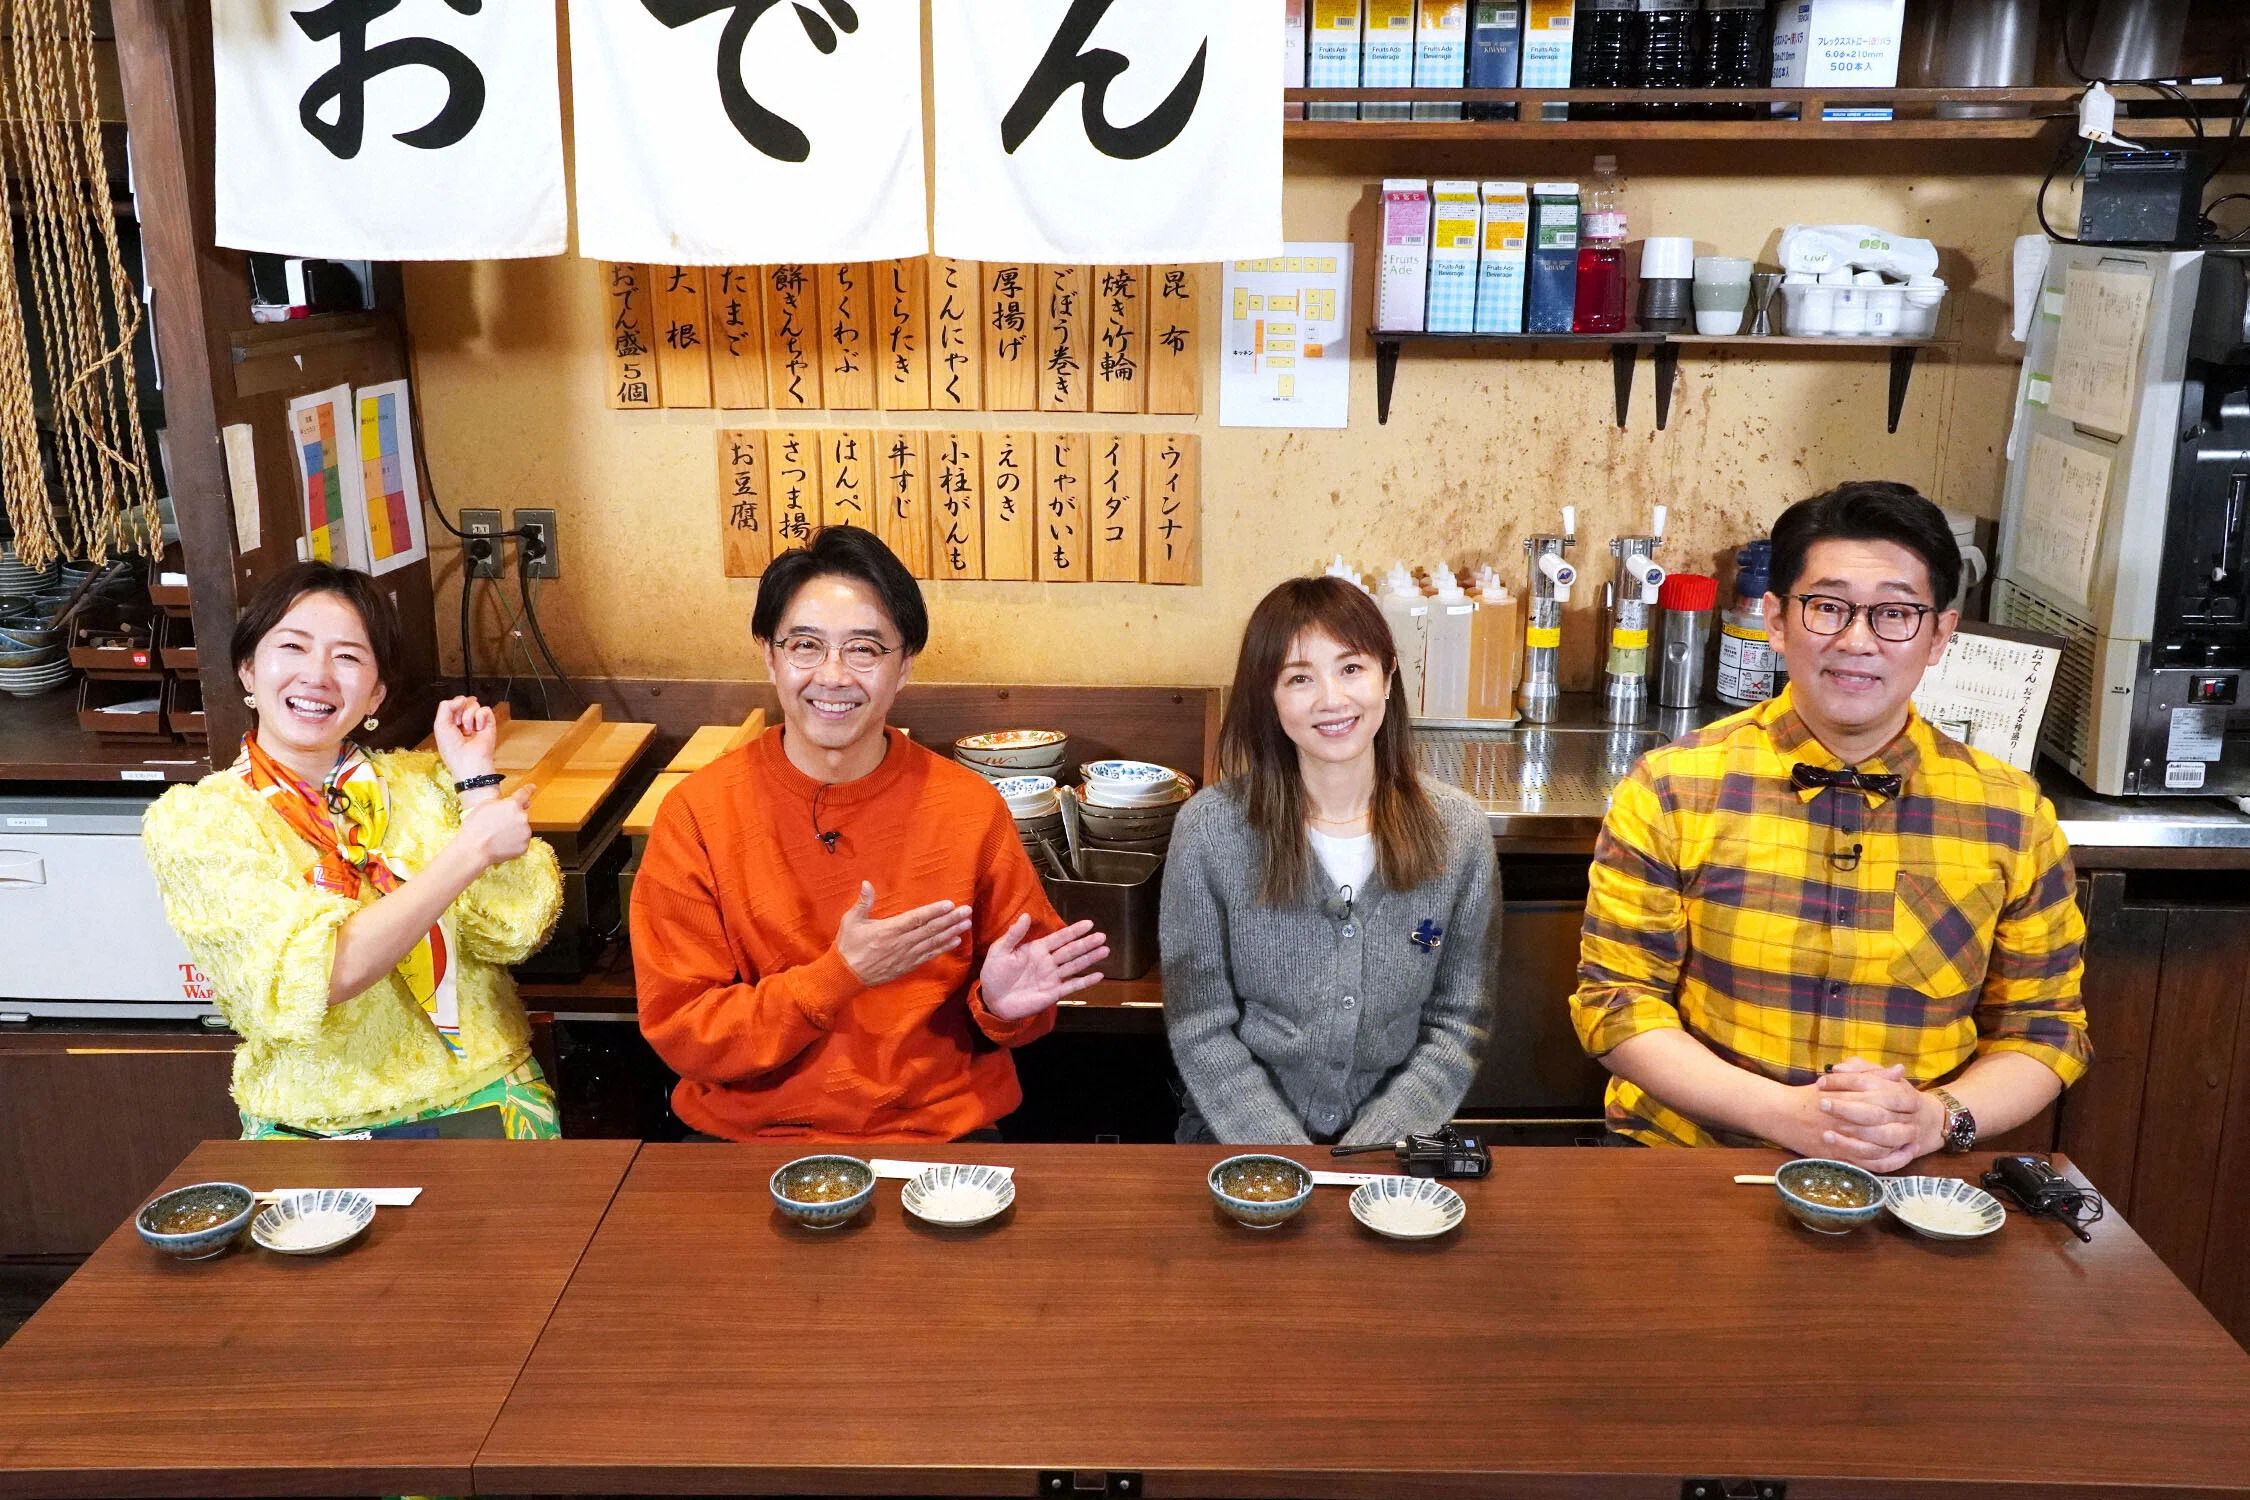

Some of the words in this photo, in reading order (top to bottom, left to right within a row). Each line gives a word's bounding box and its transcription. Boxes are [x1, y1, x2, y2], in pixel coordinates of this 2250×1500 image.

[1830, 62, 1873, 71] 500本入
[665, 266, 701, 350] 大根
[721, 267, 748, 356] たまご
[992, 267, 1027, 361] 厚揚げ
[1160, 270, 1191, 357] 昆布
[1390, 265, 1413, 274] Ade
[611, 265, 649, 403] おでん盛5個
[771, 264, 808, 403] 餅きんちゃく
[832, 266, 859, 373] ちくわぶ
[889, 267, 915, 383] しらたき
[939, 266, 968, 403] こんにゃく
[1047, 268, 1080, 403] ごぼう巻き
[1100, 269, 1138, 382] 焼き竹輪
[730, 443, 759, 532] お豆腐
[778, 438, 811, 548] さつま揚
[834, 439, 862, 527] はんぺ
[888, 440, 916, 519] 牛すじ
[938, 441, 973, 571] 小柱がんも
[996, 443, 1020, 522] えのき
[1048, 444, 1077, 569] じゃがいも
[1103, 442, 1130, 542] イイダコ
[1158, 445, 1183, 561] ウィンナー
[2024, 648, 2044, 684] おでん
[178, 963, 210, 982] TO
